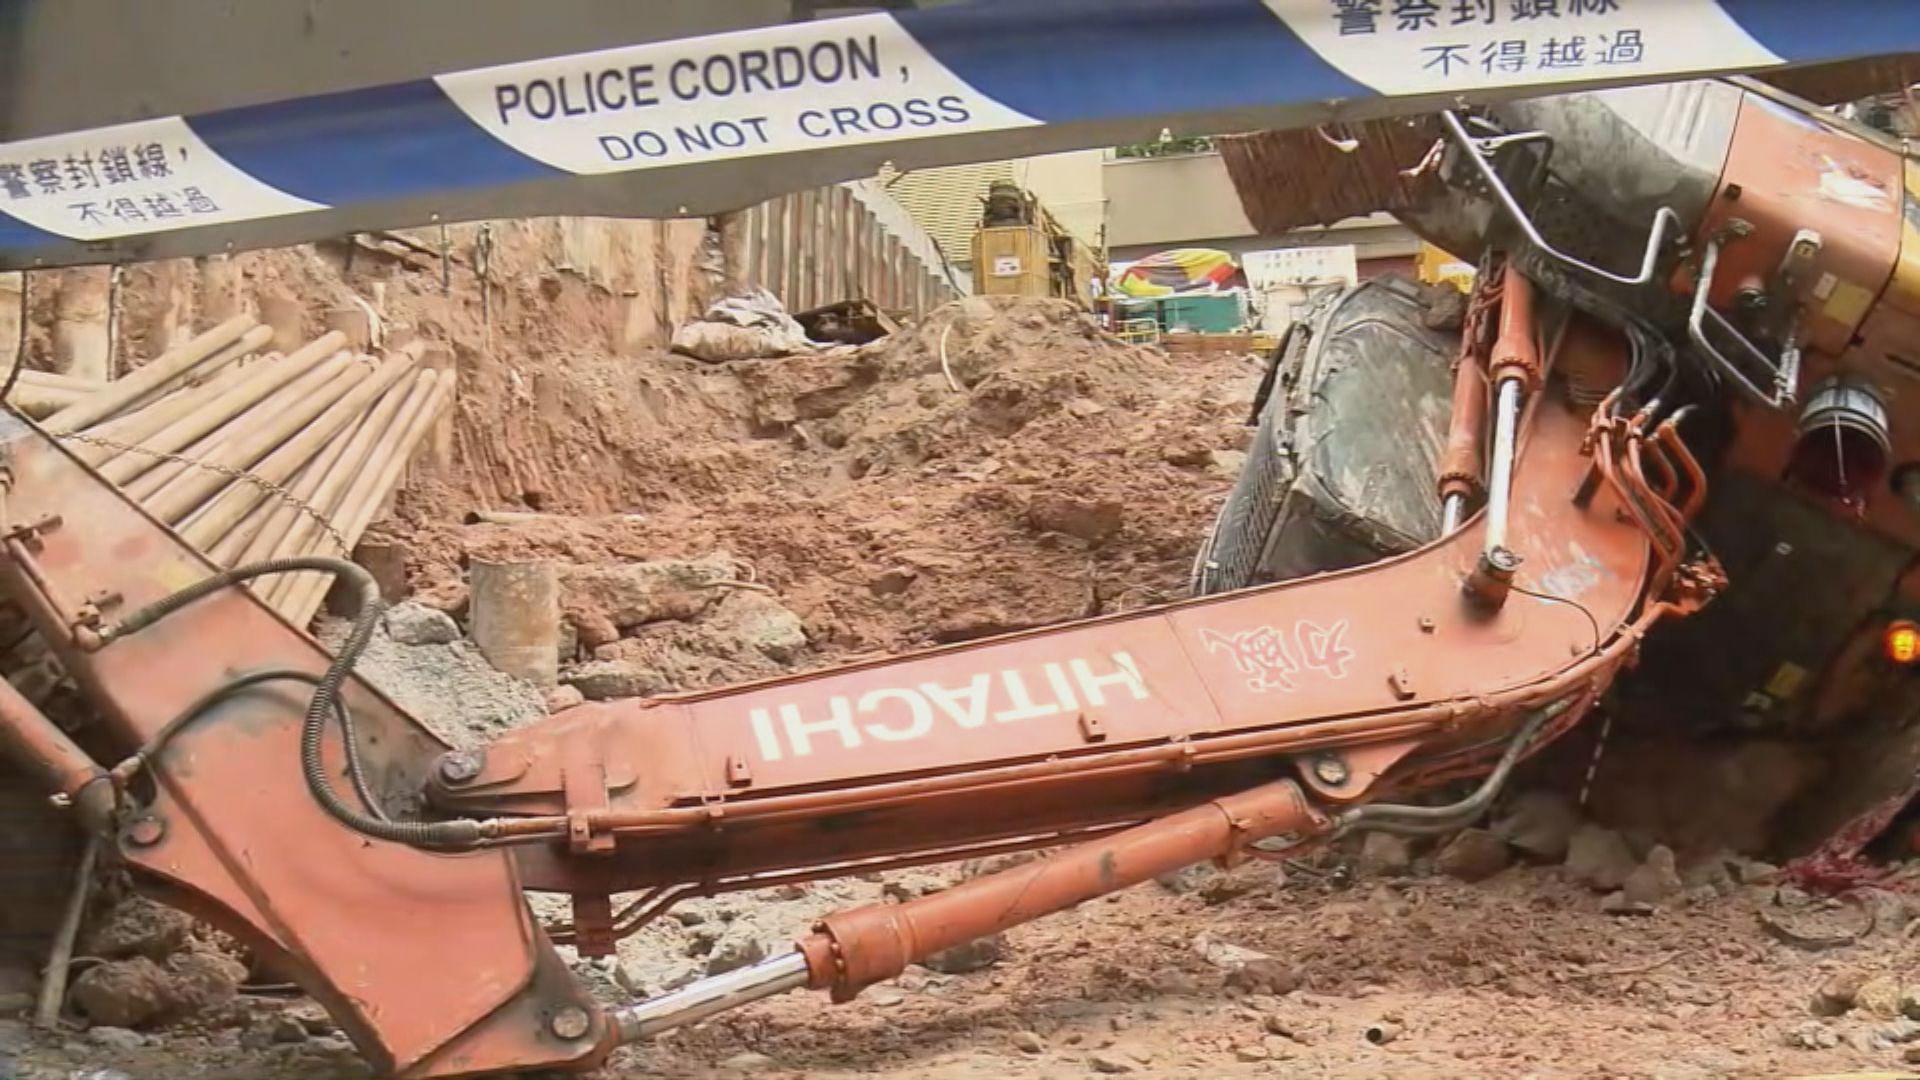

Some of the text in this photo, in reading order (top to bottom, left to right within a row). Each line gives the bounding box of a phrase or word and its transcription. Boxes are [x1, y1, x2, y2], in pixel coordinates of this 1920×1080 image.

[1421, 30, 1645, 76] 不得越過
[495, 65, 659, 124] POLICE
[598, 94, 972, 162] DO NOT CROSS
[749, 650, 1149, 762] HITACHI
